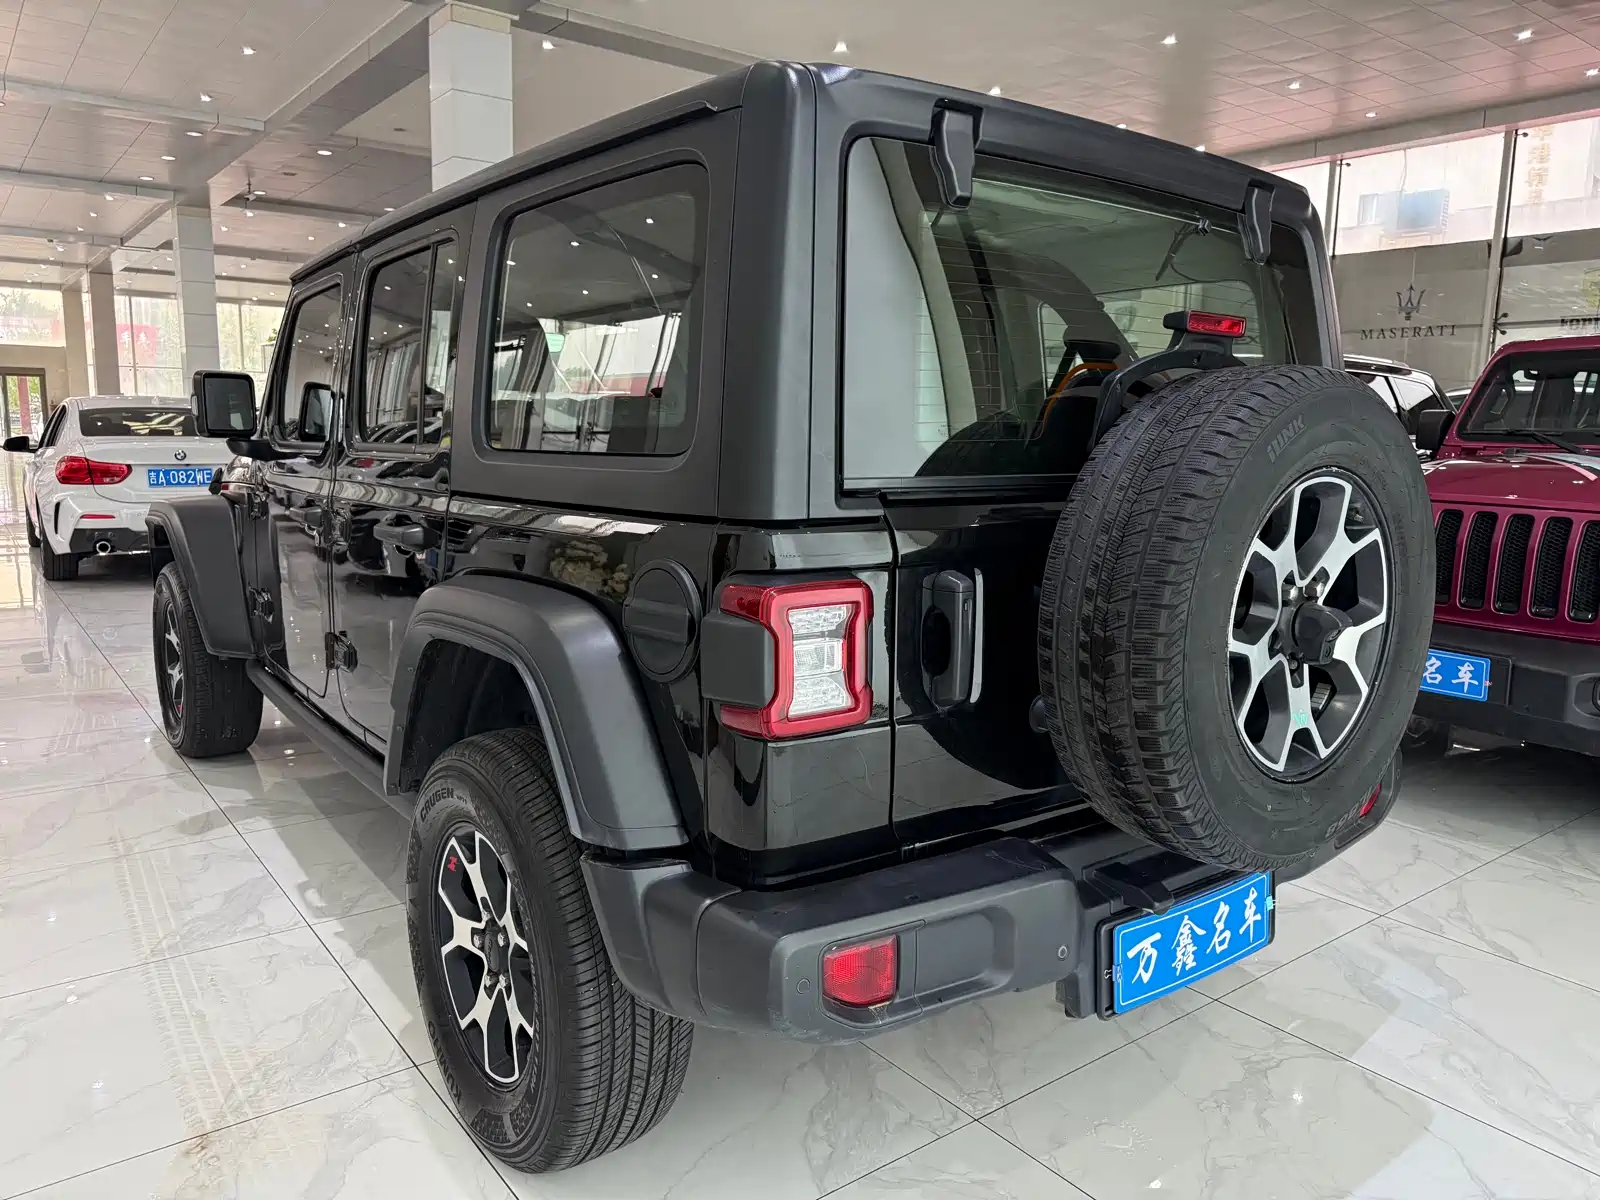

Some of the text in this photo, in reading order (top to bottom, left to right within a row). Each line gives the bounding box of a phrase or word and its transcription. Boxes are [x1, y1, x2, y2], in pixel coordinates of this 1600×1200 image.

[1360, 324, 1457, 341] MASERATI
[1126, 886, 1262, 985] 万鑫名车
